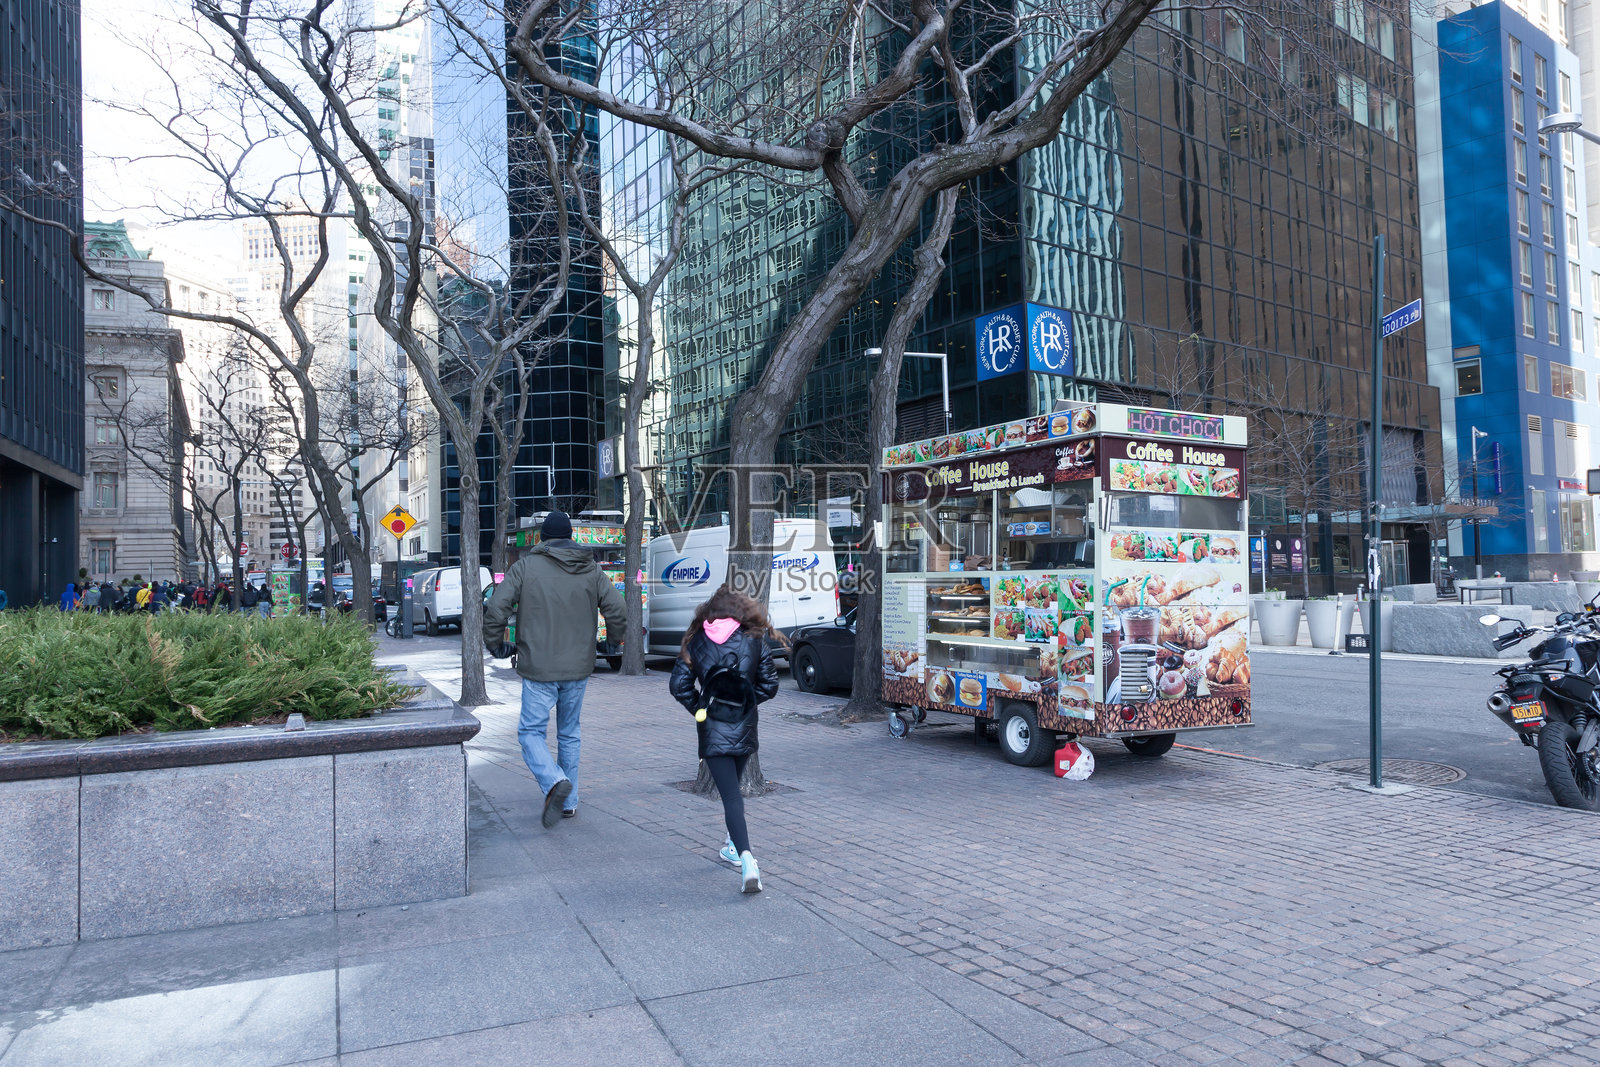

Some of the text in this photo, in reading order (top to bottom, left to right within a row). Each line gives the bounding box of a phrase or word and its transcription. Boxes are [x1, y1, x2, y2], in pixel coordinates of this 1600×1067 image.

[983, 315, 1000, 335] HEALTH
[1034, 310, 1052, 326] HEALTH
[1052, 312, 1056, 320] &
[1005, 315, 1021, 343] RACQUET
[1056, 316, 1069, 349] RACQUET
[981, 355, 991, 371] NEW
[1009, 344, 1020, 364] CLUB
[1033, 345, 1043, 363] NEW
[1060, 349, 1069, 366] CLUB
[1130, 413, 1165, 432] HOT
[1055, 446, 1074, 457] Coffee
[1126, 441, 1226, 467] Coffee House
[925, 465, 962, 487] Coffee
[969, 461, 1010, 481] House
[972, 472, 1045, 492] Breakfast & Lunch
[282, 546, 297, 554] STP
[772, 557, 808, 570] EMPIRE
[672, 566, 700, 581] EMPIRE
